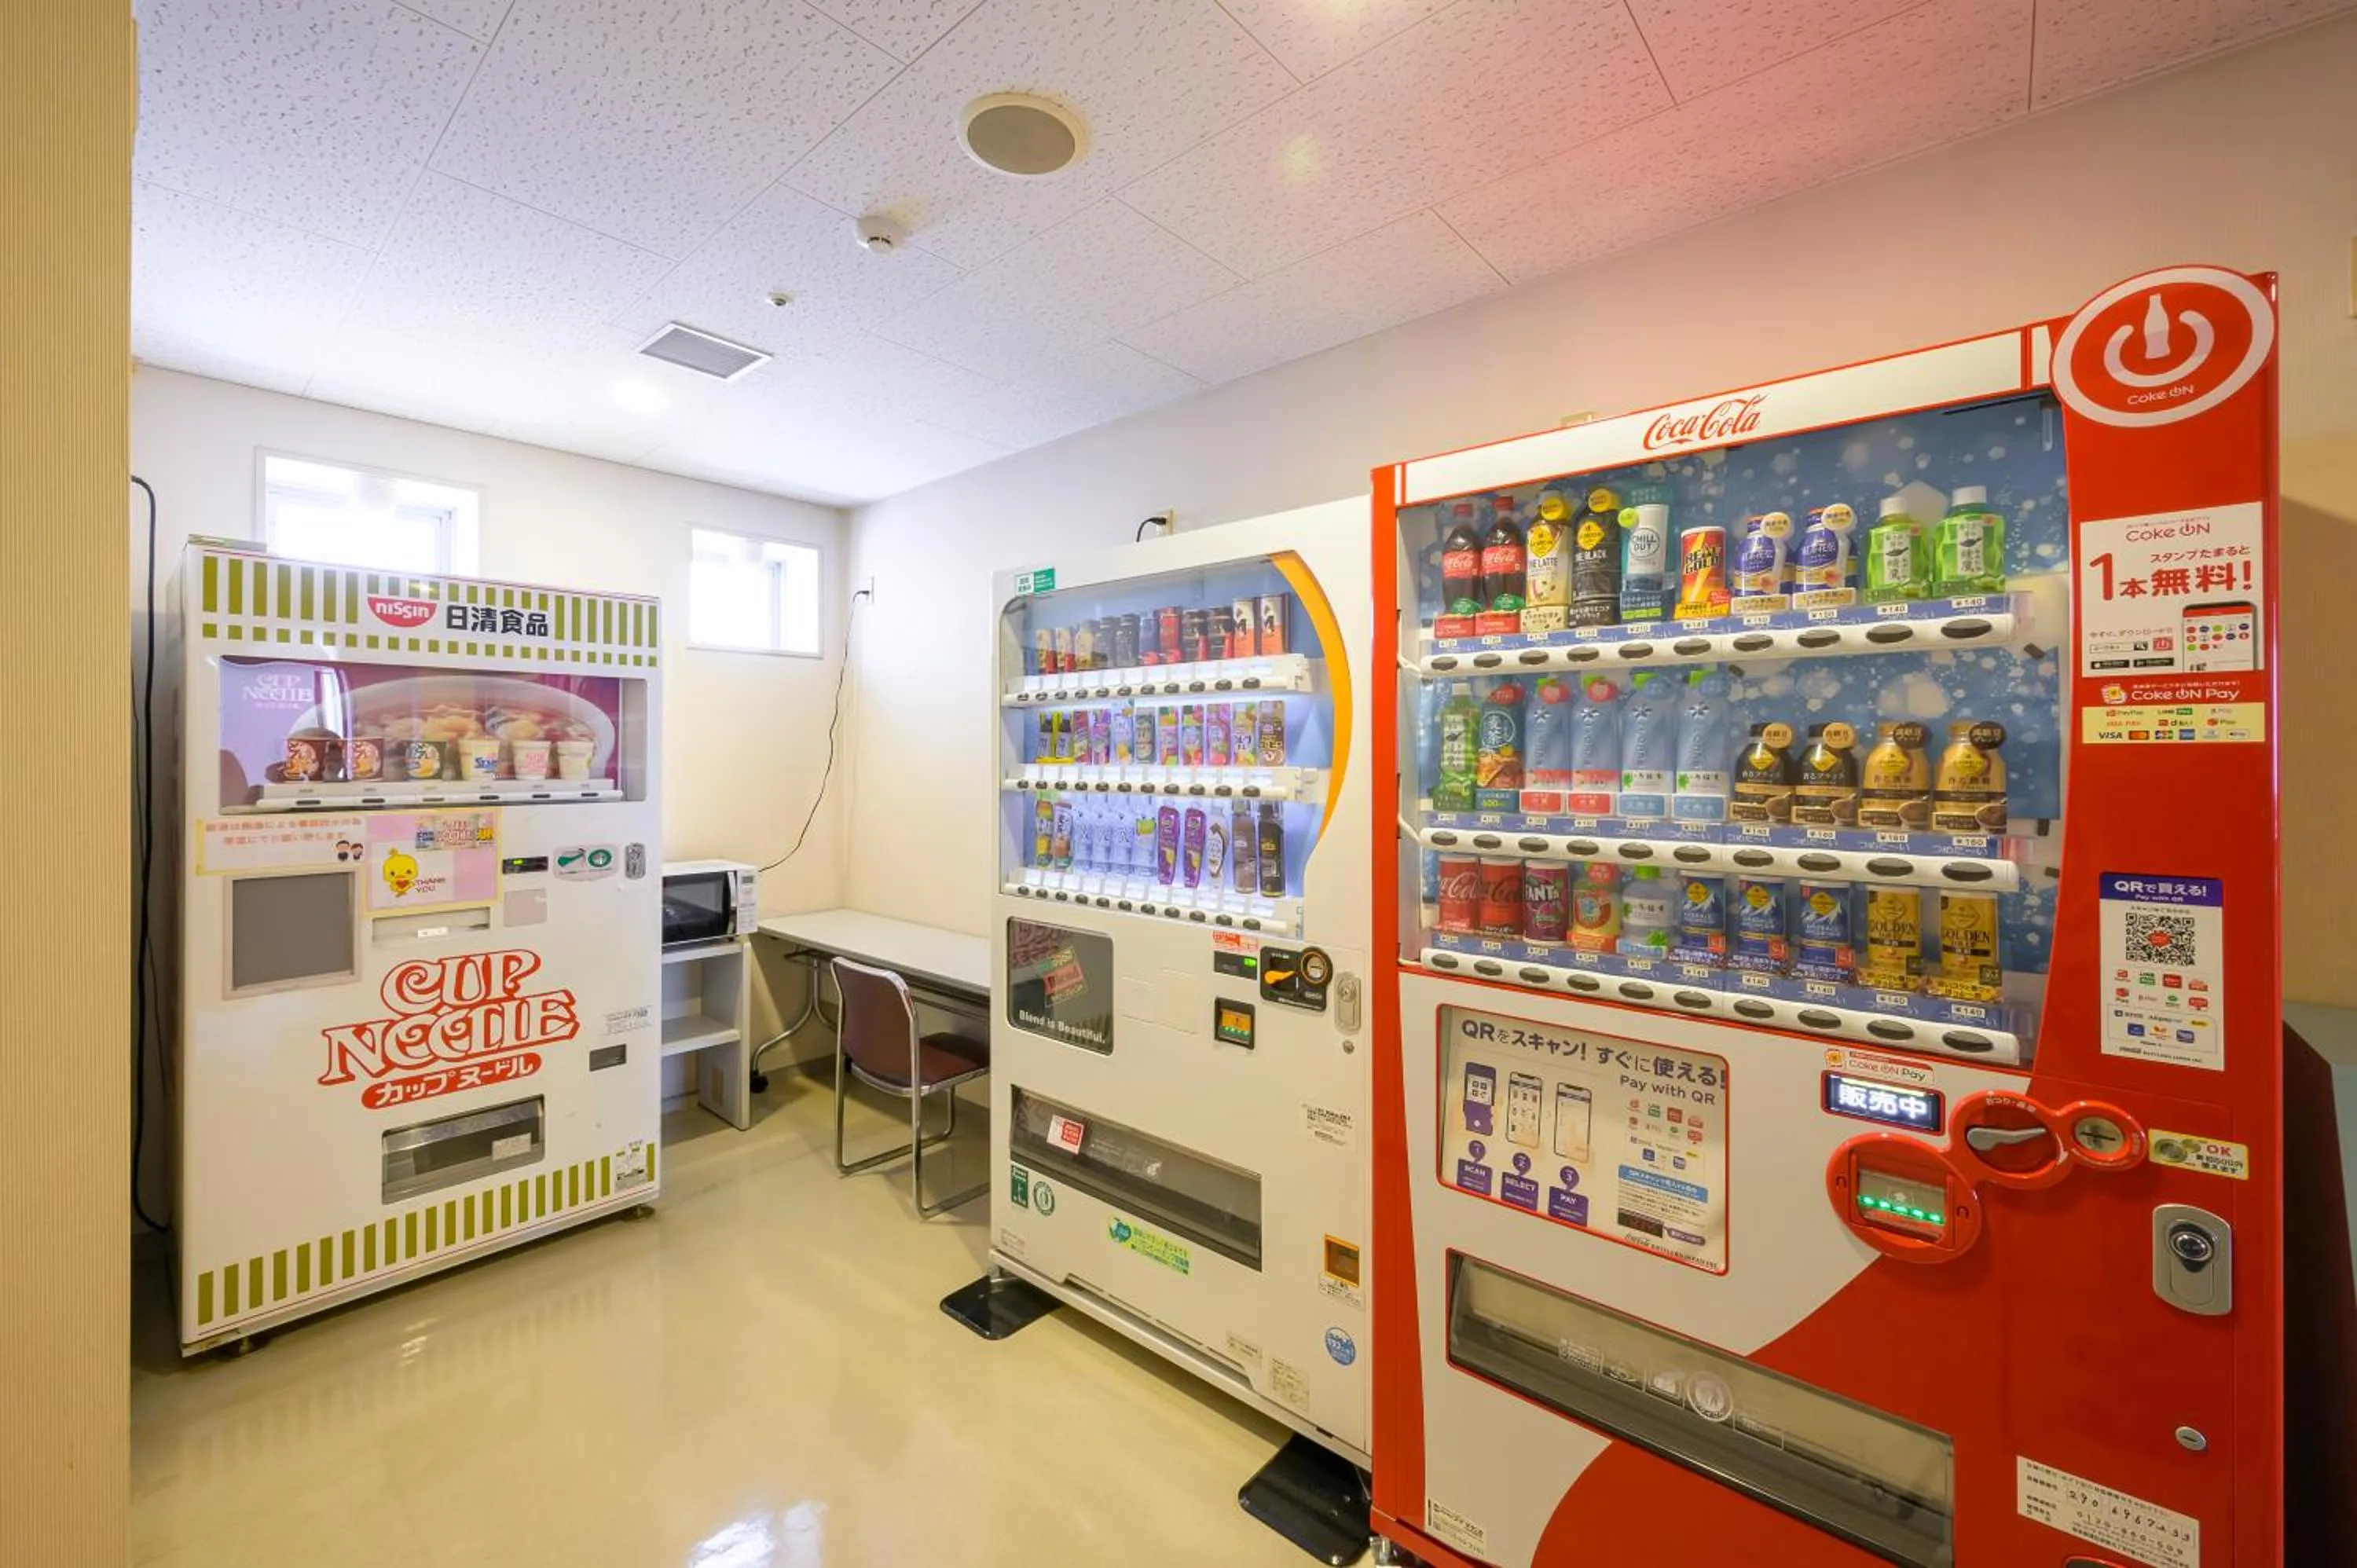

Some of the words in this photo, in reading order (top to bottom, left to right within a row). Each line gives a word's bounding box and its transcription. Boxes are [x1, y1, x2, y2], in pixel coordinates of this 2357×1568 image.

[2127, 390, 2167, 405] Coke
[1643, 394, 1769, 450] Coca-Cola
[2125, 526, 2176, 542] Coke
[2150, 544, 2251, 564] スタンプたまると
[445, 604, 550, 638] 日清食品
[2132, 688, 2173, 702] Coke
[2205, 688, 2240, 702] Pay
[2114, 880, 2208, 897] QRで買える!
[380, 948, 542, 1017] CUP
[1019, 1009, 1045, 1026] Blend
[317, 989, 581, 1086] NOODLE
[1461, 1019, 1587, 1061] QRをスキャン!
[1596, 1046, 1727, 1090] すぐに使える!
[375, 1057, 535, 1106] カップヌードル
[1901, 1068, 1926, 1083] Pay
[1620, 1075, 1647, 1093] Pay
[1651, 1081, 1686, 1098] with
[1691, 1090, 1717, 1106] QR
[1838, 1083, 1928, 1119] 販売中
[2207, 1145, 2231, 1156] OK
